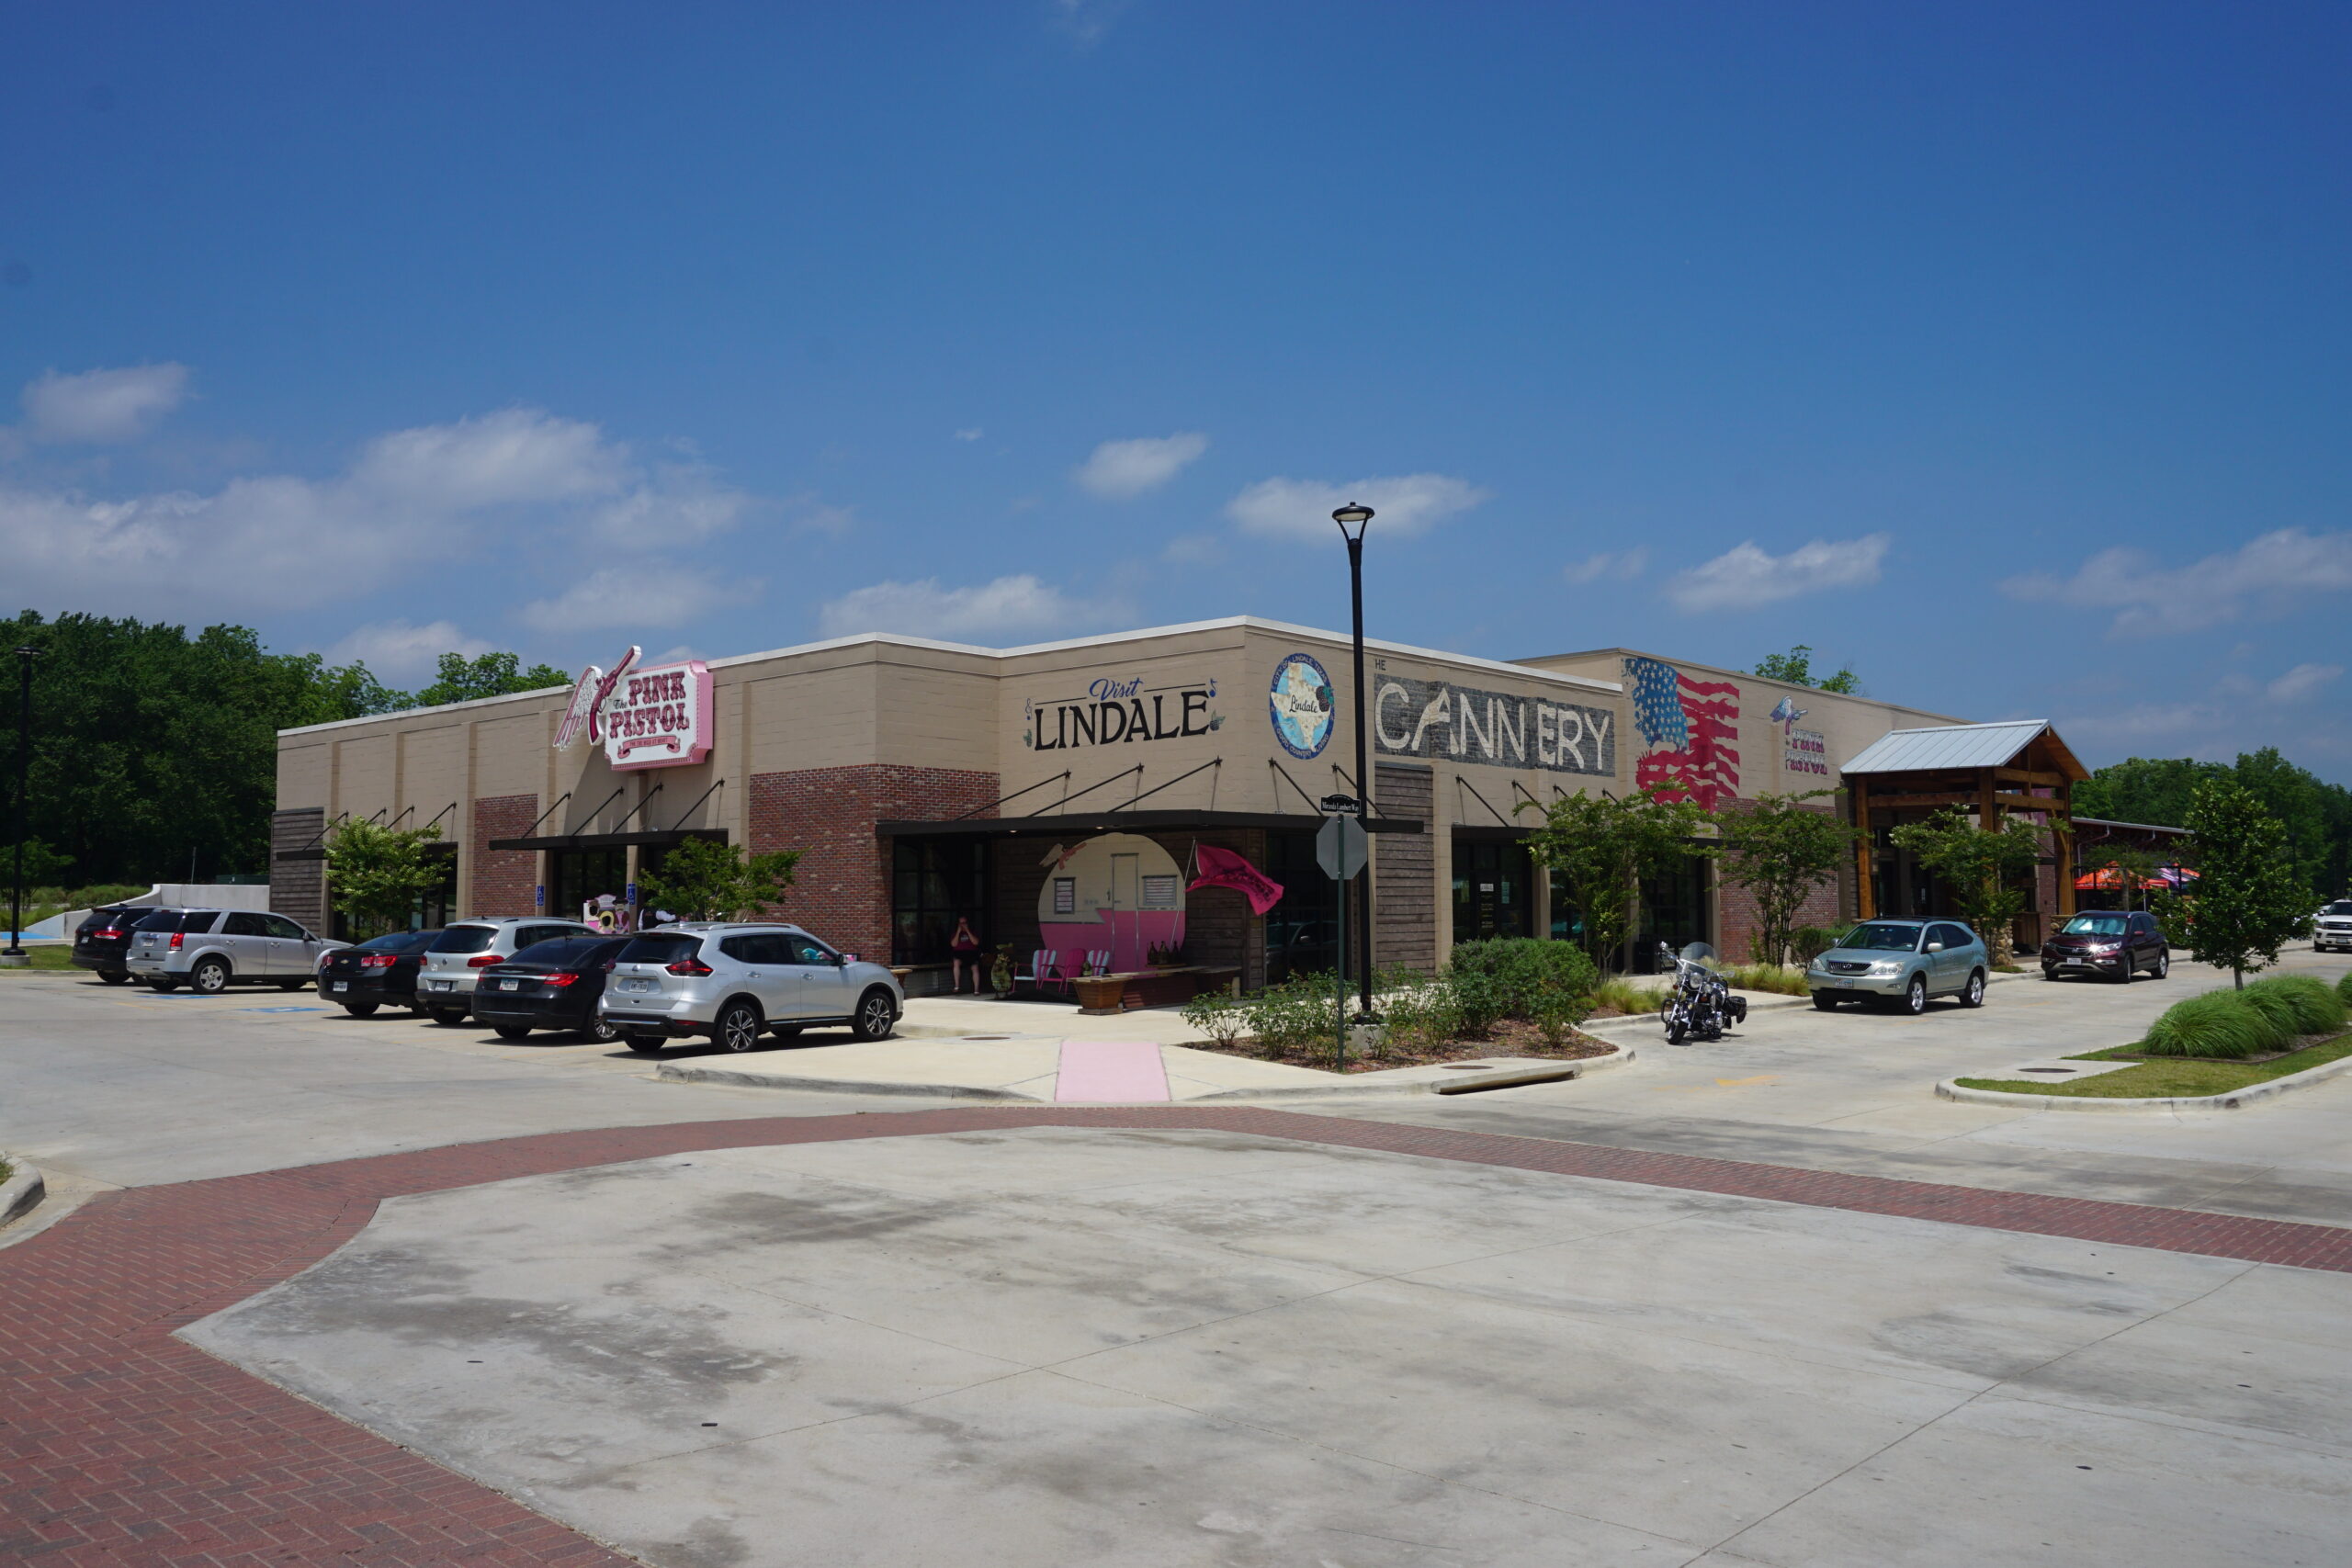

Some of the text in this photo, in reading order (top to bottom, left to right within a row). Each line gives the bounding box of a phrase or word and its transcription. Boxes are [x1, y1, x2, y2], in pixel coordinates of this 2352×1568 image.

[1292, 655, 1314, 665] LINDALE
[1314, 663, 1328, 683] TEXAS
[628, 671, 686, 706] PINK
[1089, 677, 1144, 701] Visit
[613, 699, 628, 709] The
[1289, 694, 1318, 713] Lindale
[609, 702, 690, 739] PISTOL
[1035, 690, 1210, 751] LINDALE
[1374, 682, 1609, 770] CANNERY
[1276, 728, 1289, 747] GOOD
[1792, 728, 1825, 753] PINK
[1785, 750, 1827, 775] PISTOL
